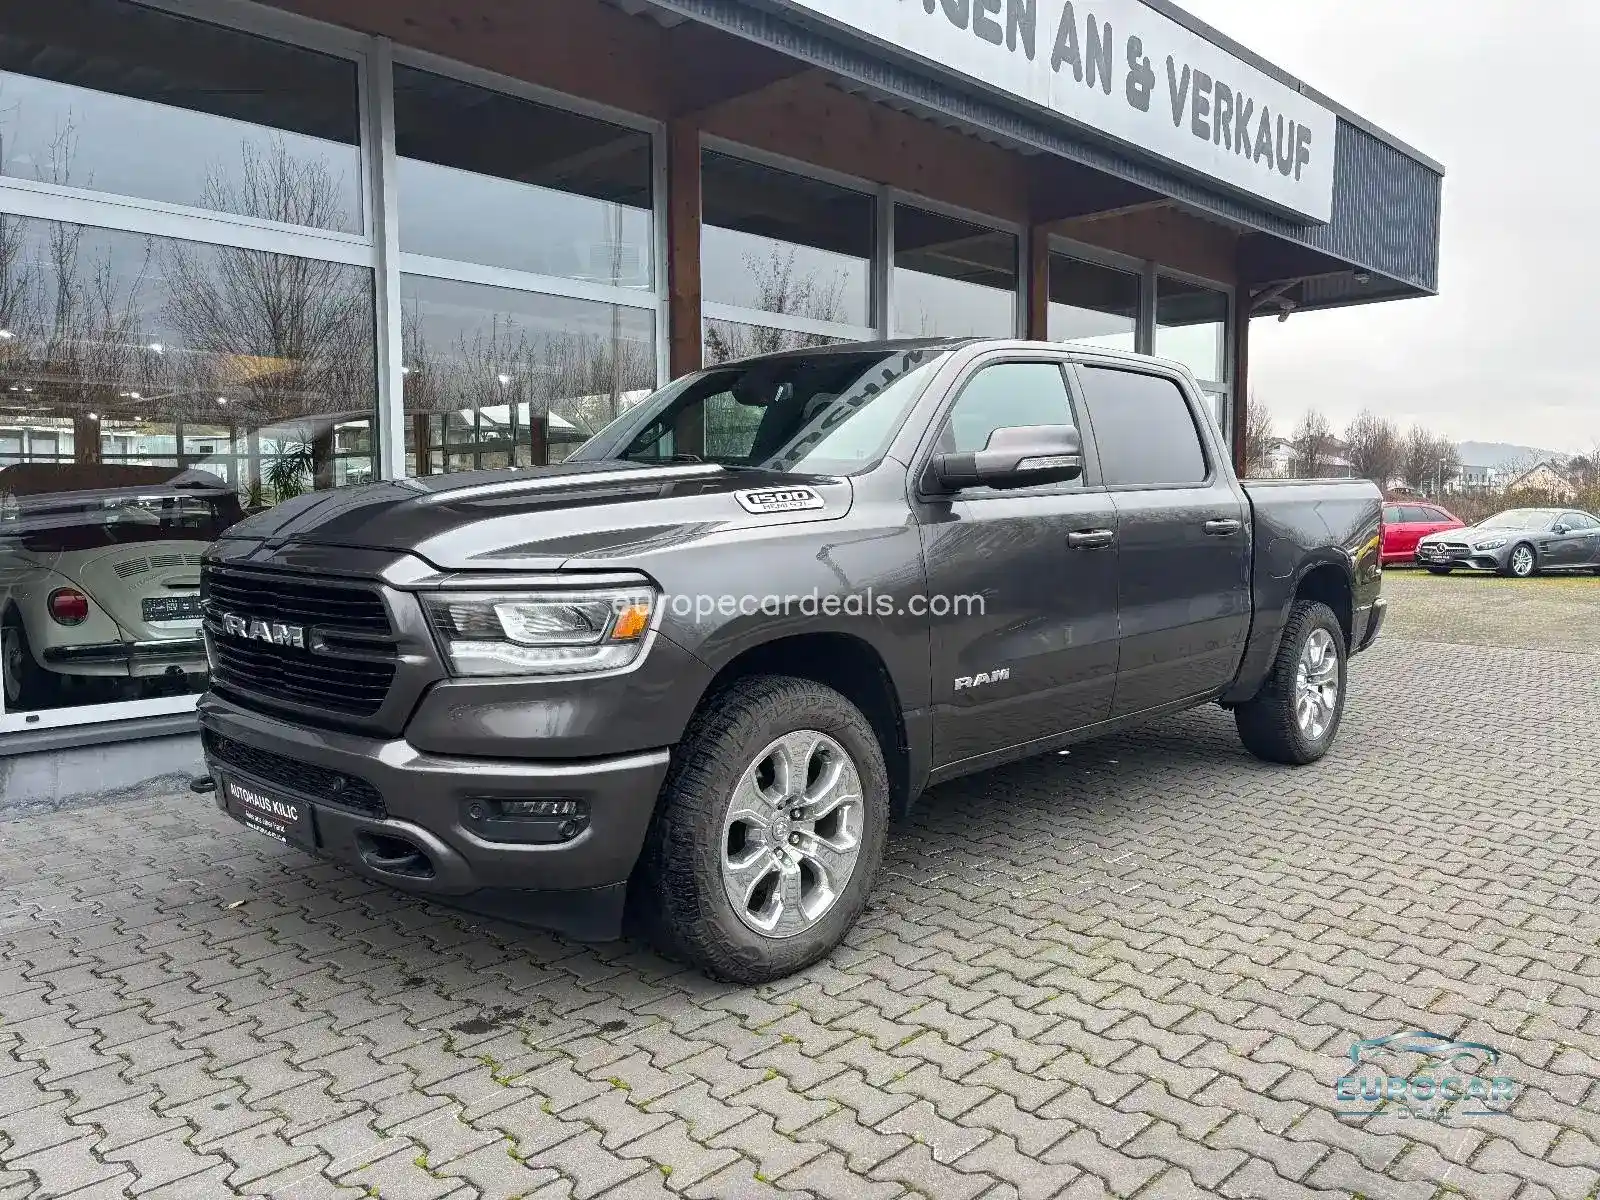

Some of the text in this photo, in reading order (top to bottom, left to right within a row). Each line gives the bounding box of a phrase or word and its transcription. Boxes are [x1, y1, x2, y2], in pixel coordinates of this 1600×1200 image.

[1051, 0, 1112, 95] AN
[1126, 35, 1155, 112] &
[1166, 55, 1312, 182] VERKAUF
[749, 490, 809, 504] 1500
[222, 612, 305, 649] RAM
[953, 667, 1011, 691] RAM
[230, 782, 272, 812] AUTOHAUS
[272, 801, 299, 821] KILIC
